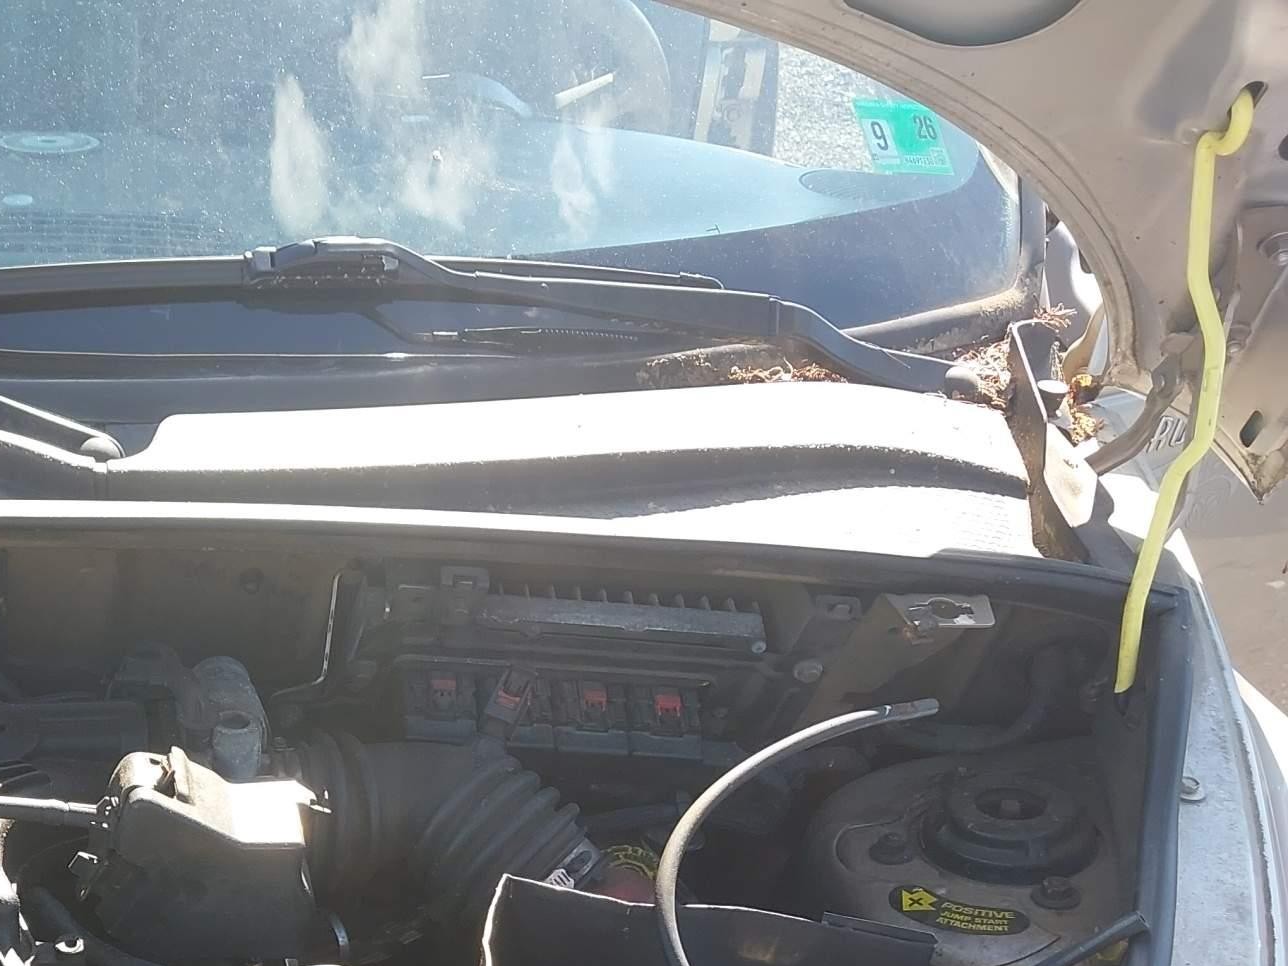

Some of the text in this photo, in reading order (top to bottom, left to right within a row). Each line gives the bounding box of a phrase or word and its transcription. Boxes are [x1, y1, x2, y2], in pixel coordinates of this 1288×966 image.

[871, 115, 937, 151] 9 26
[940, 911, 1009, 925] JUMP START
[941, 902, 1016, 919] POSITIVE
[936, 918, 1009, 932] ATTACHMENT
